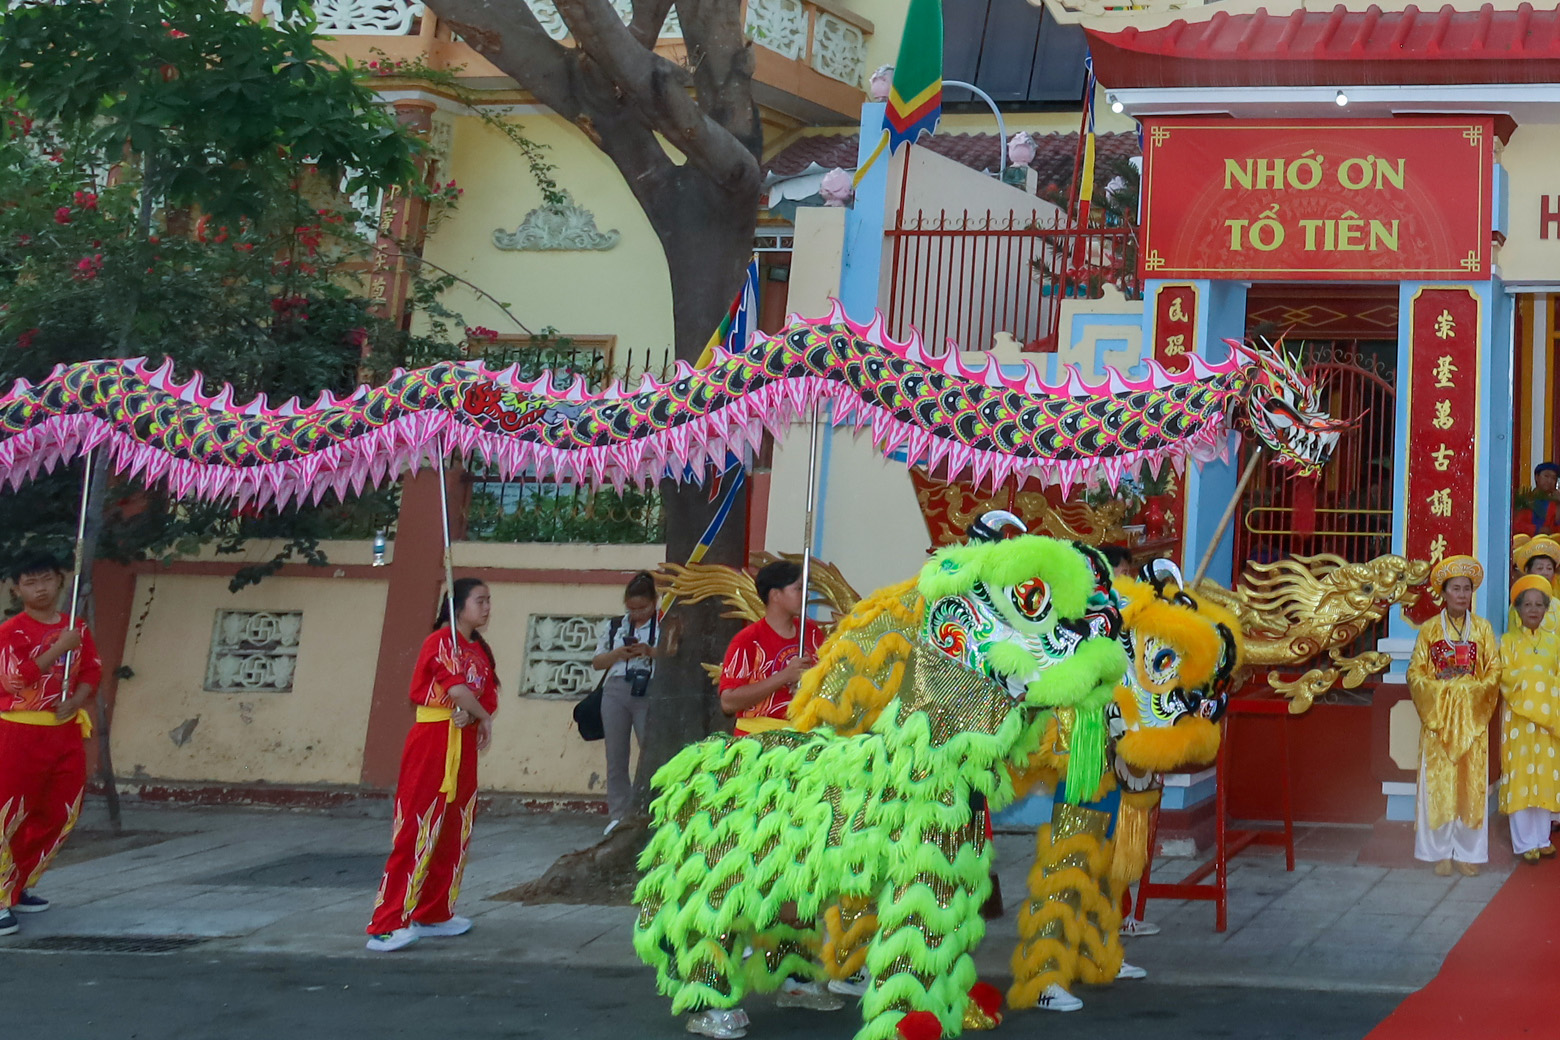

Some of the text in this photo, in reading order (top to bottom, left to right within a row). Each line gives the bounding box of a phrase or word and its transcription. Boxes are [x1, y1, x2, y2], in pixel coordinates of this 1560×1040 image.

[1223, 148, 1406, 191] NHỚ ƠN
[1223, 203, 1400, 252] TỔ TIÊN
